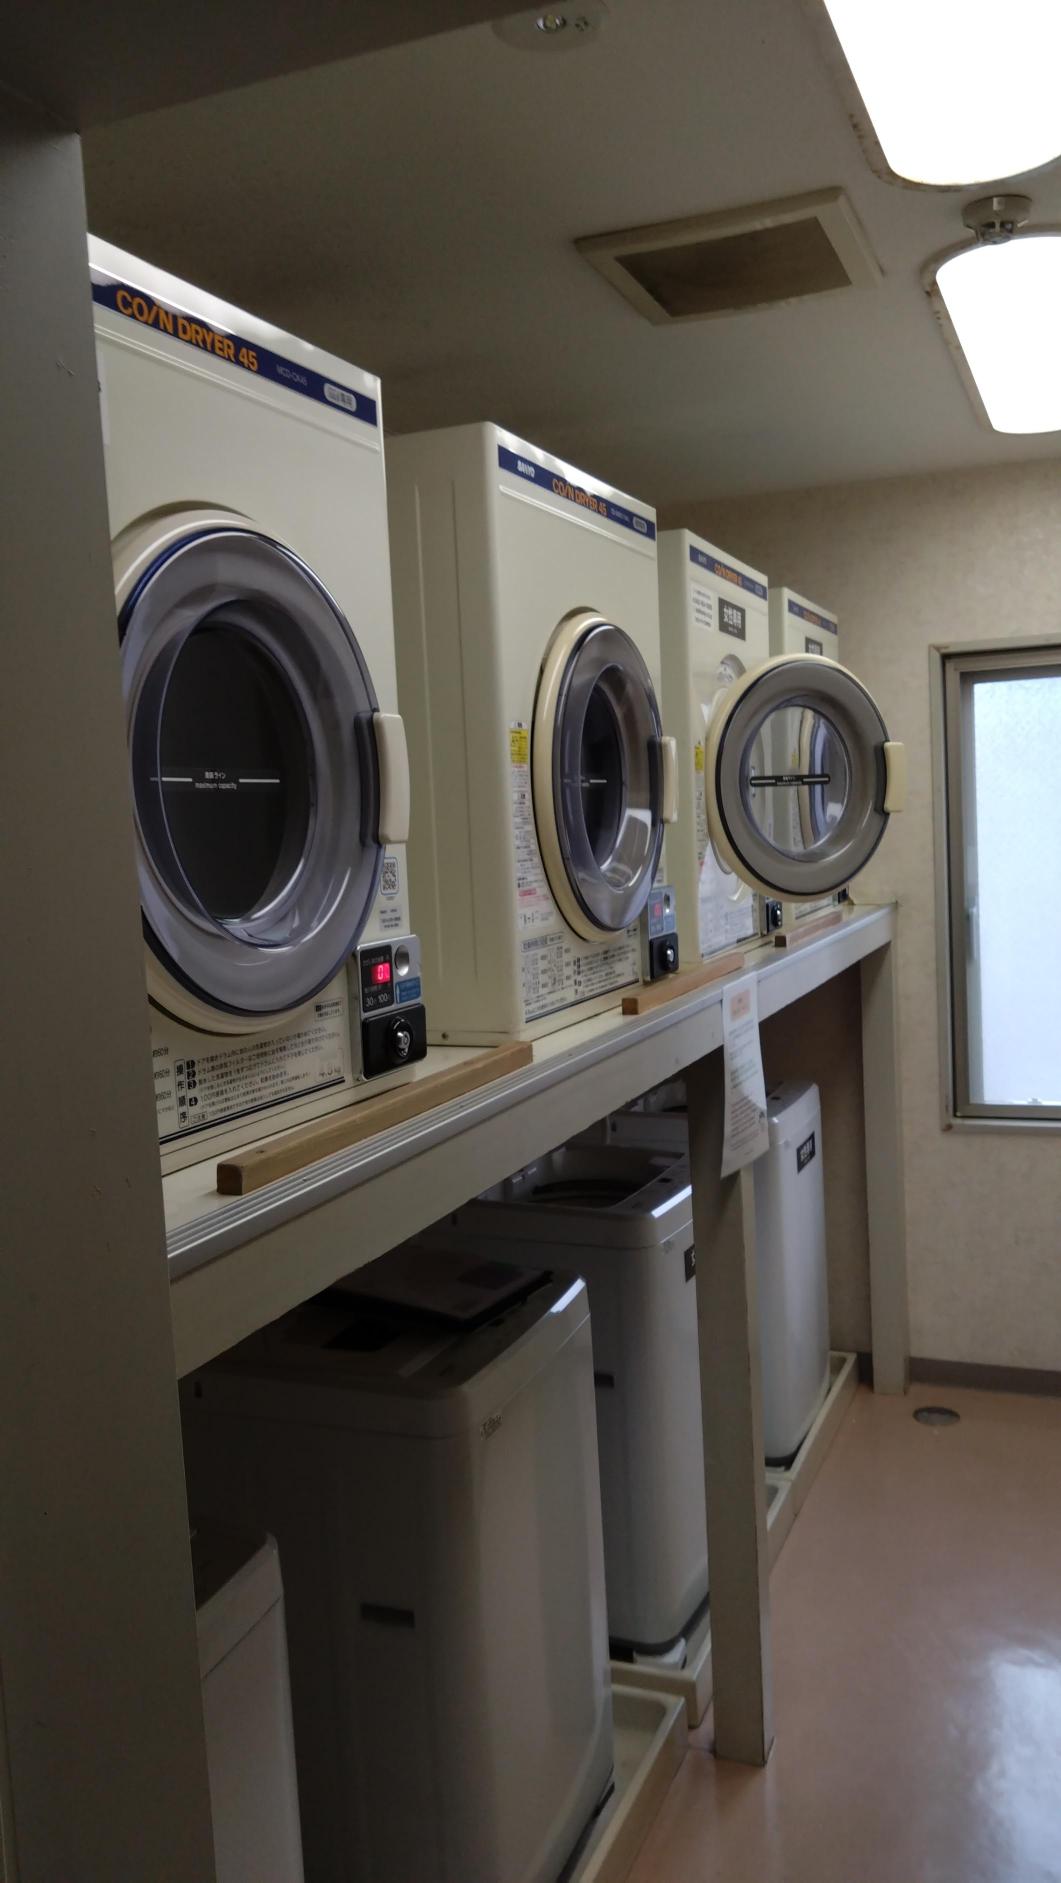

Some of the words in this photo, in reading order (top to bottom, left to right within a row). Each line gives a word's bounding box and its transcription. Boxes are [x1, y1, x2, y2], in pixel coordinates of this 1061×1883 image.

[177, 316, 236, 361] DRYER
[238, 346, 259, 372] 45
[575, 490, 599, 512] DRYER
